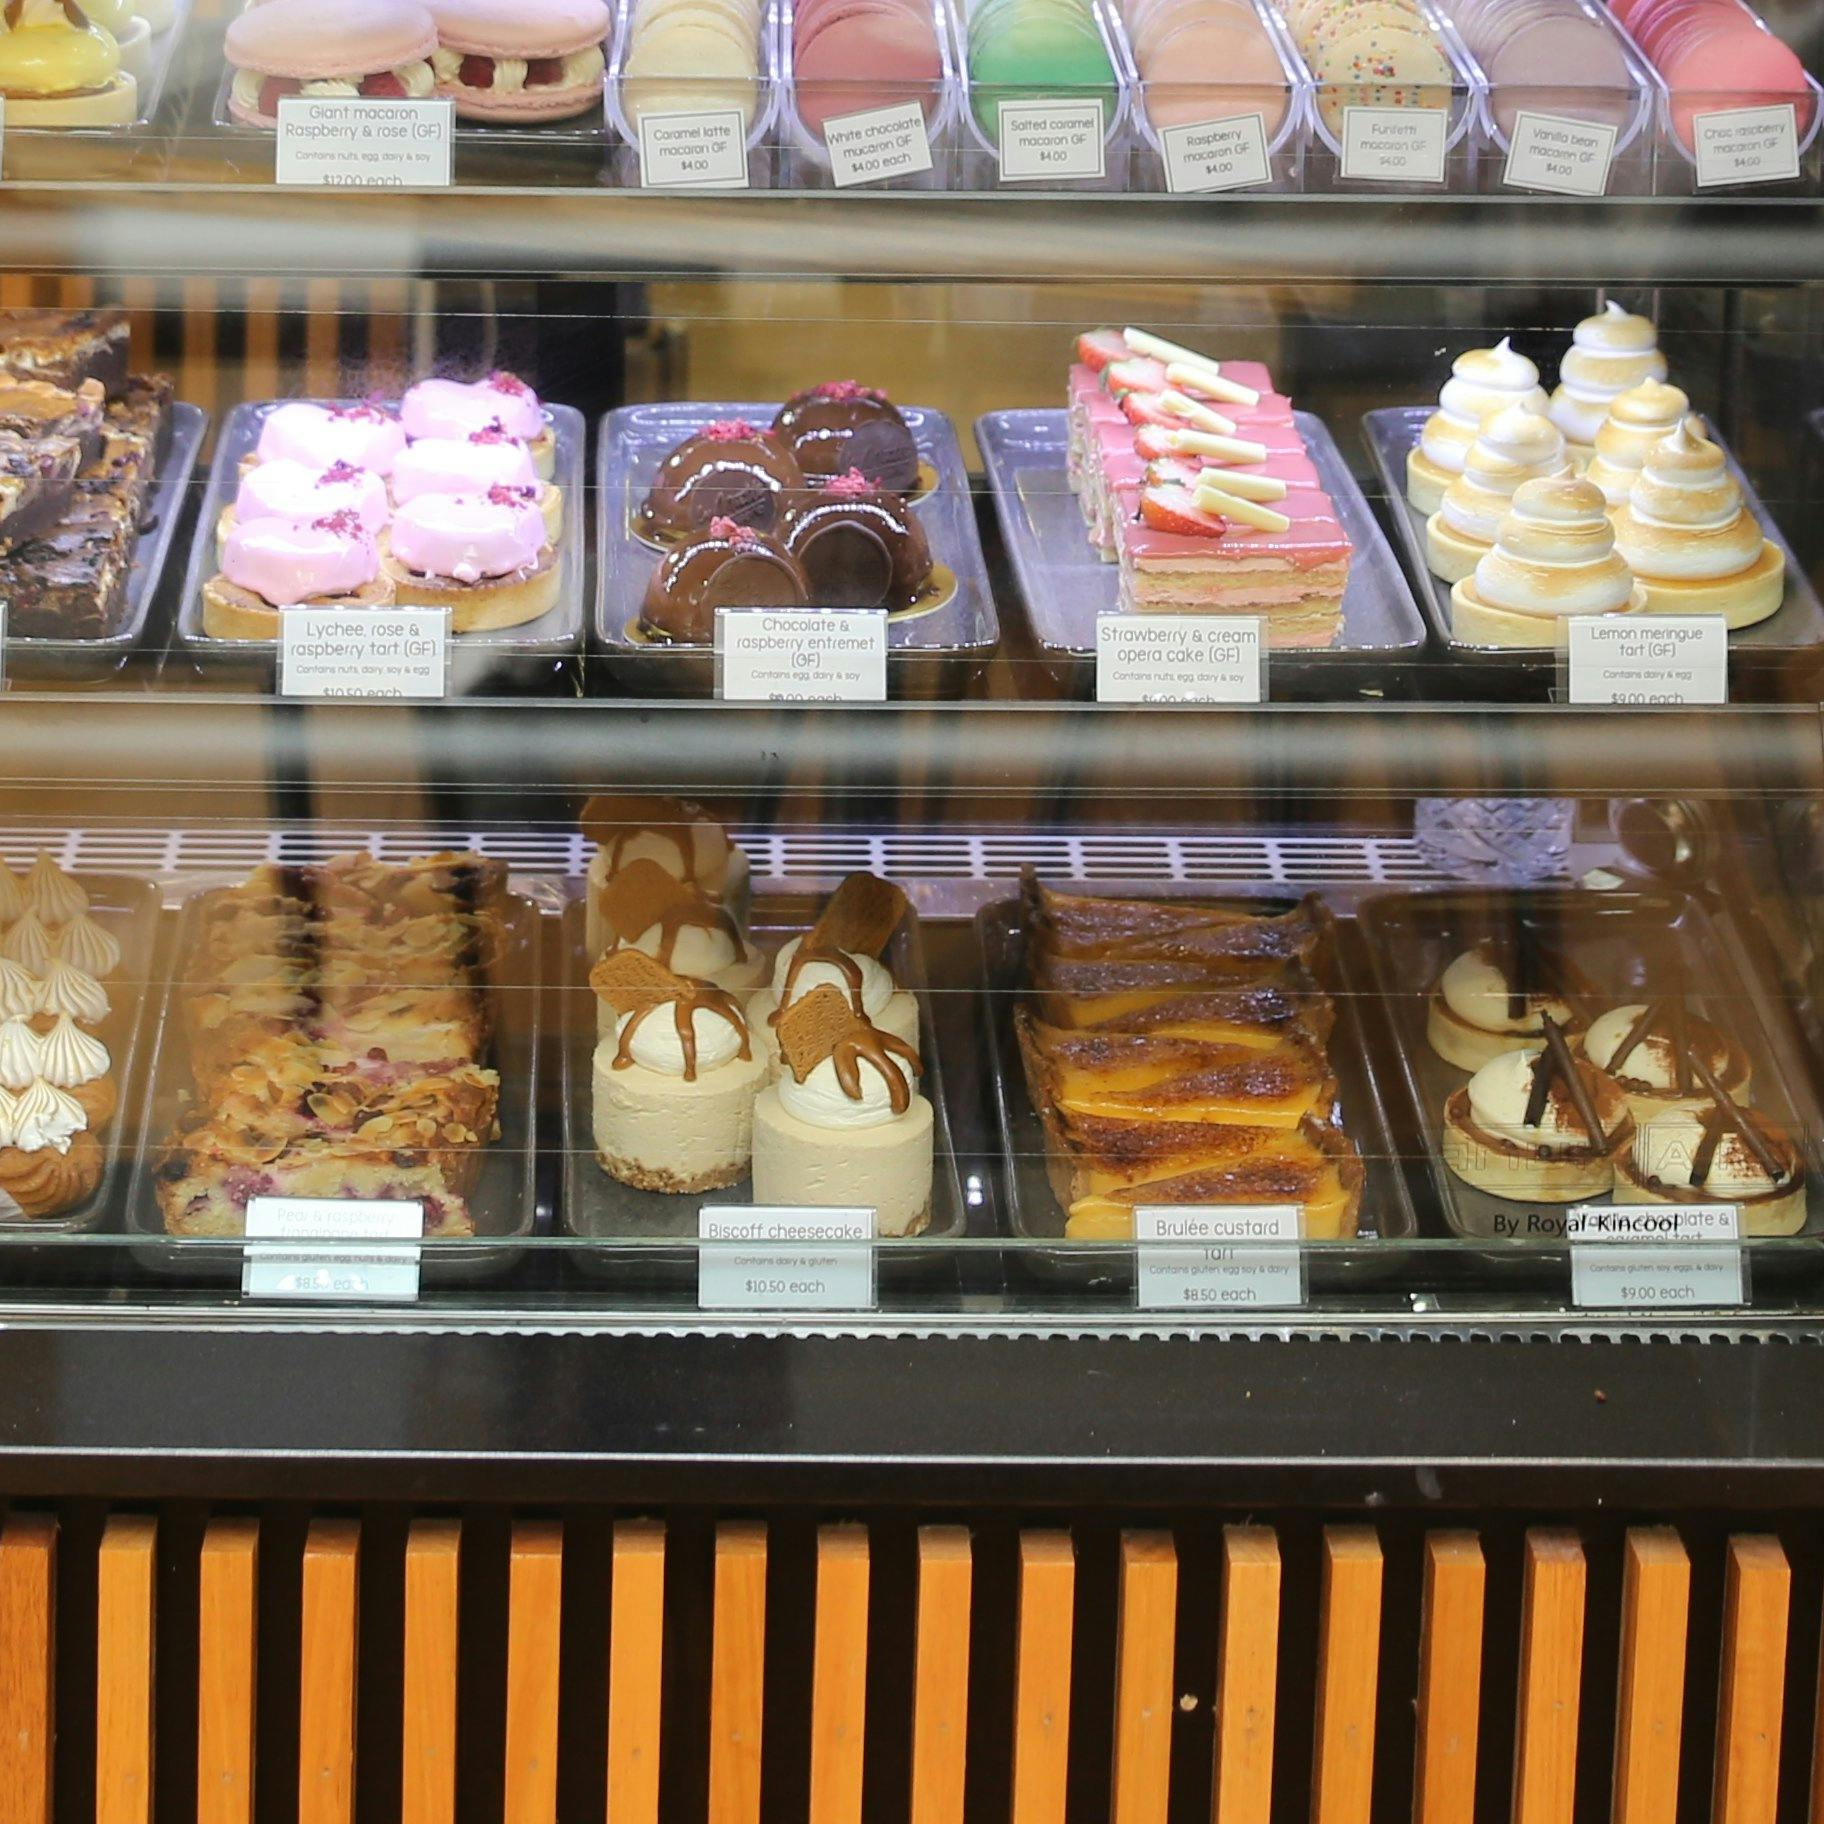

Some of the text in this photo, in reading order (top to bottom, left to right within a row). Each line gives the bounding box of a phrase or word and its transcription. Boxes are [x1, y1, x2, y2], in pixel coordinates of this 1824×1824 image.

[309, 104, 419, 122] Giant macaron
[286, 121, 443, 141] Raspberry & rose (GF)
[828, 117, 922, 146] White chocolate
[1011, 117, 1094, 132] Salted caramel
[1371, 123, 1417, 136] Funfetti
[1704, 122, 1786, 141] Choc raspberry
[653, 126, 732, 142] Caramel latte
[1019, 133, 1087, 148] macaron GF
[1187, 129, 1243, 147] Raspberry
[1533, 128, 1598, 149] Vanilla bean
[659, 141, 728, 157] macaron GF
[843, 134, 912, 159] macaron GF
[1183, 141, 1250, 163] macaron GF
[1360, 139, 1427, 152] macaron GF
[1529, 144, 1578, 160] macaron
[1713, 136, 1778, 155] macaron GF
[882, 152, 912, 167] each
[306, 621, 420, 640] Lychee, rose &
[762, 617, 850, 633] Chocolate &
[1100, 626, 1257, 647] Strawberry & cream
[1591, 626, 1704, 643] Lemon meringue
[290, 639, 437, 660] raspberry tart (GF)
[736, 635, 875, 653] raspberry entremet
[1620, 643, 1677, 659] tart (GF)
[791, 652, 822, 669] (GF)
[1117, 646, 1241, 666] opera cake (GF)
[1603, 669, 1694, 681] Contains dairy & egg
[1650, 692, 1685, 704] each
[708, 1223, 863, 1239] Biscoff cheesecake
[1157, 1218, 1280, 1237] Brulée custard
[1493, 1212, 1679, 1238] By Royal Kincool
[735, 1256, 838, 1267] Contains dairy & gluten
[745, 1279, 826, 1294] $10.50 each
[1183, 1287, 1257, 1302] $8.50 each
[1621, 1286, 1696, 1300] $9.00 each
